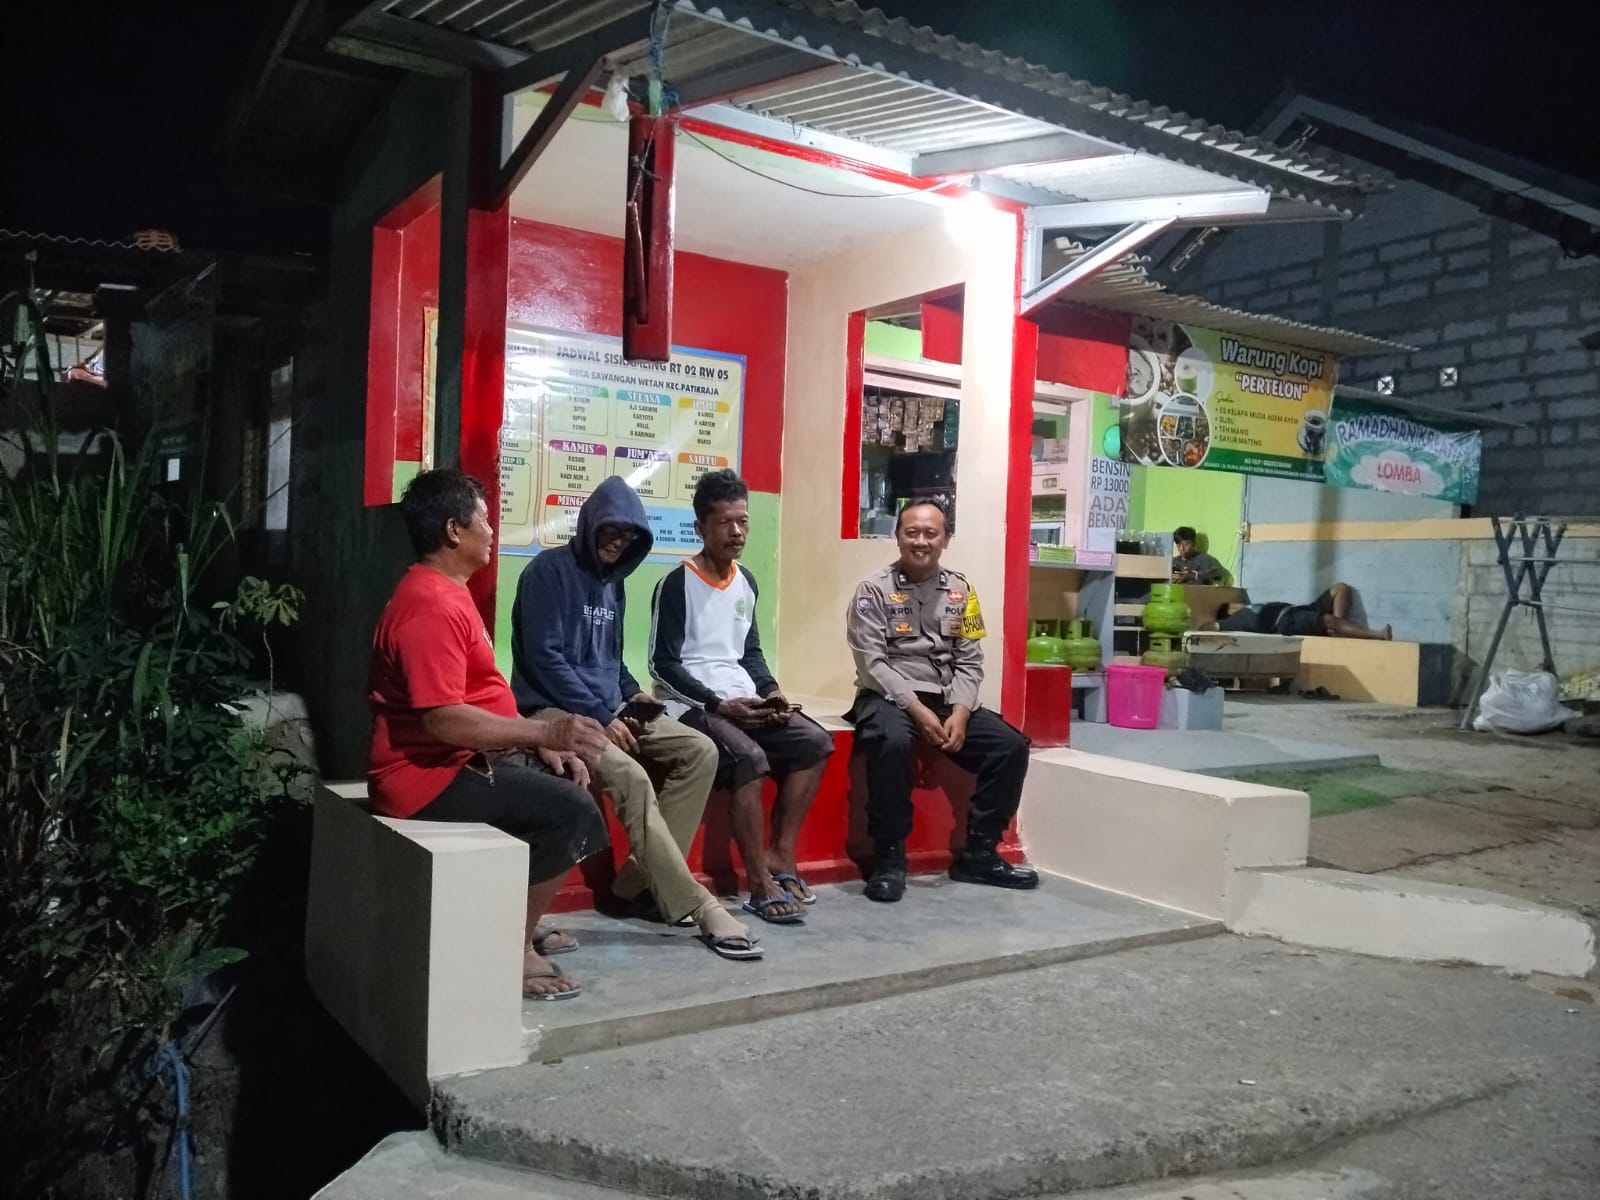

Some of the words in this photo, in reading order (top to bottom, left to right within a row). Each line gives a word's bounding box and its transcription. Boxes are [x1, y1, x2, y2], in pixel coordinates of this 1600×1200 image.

[556, 346, 601, 362] JADWAL
[669, 362, 682, 374] RT
[684, 364, 697, 376] 02
[699, 366, 715, 378] RW
[717, 369, 729, 380] 05
[1221, 337, 1287, 375] Warung
[1289, 352, 1325, 380] Kopi
[591, 371, 636, 385] SAWANGAN
[638, 377, 664, 388] WETAN
[627, 392, 661, 403] SELASA
[1227, 408, 1249, 416] KELAPA
[1219, 416, 1235, 424] SUSU
[1219, 425, 1230, 433] TEH
[1230, 427, 1249, 436] MANIS
[1219, 435, 1238, 443] SAYUR
[563, 441, 594, 453] KAMIS
[688, 454, 717, 466] SABTU
[1092, 458, 1131, 477] BENSIN
[1377, 462, 1422, 484] LOMBA
[1091, 478, 1101, 491] RP
[1103, 478, 1129, 493] 13000
[557, 495, 588, 506] MING
[1090, 496, 1127, 513] ADA
[1088, 512, 1128, 528] BENSIN
[945, 606, 965, 616] POL
